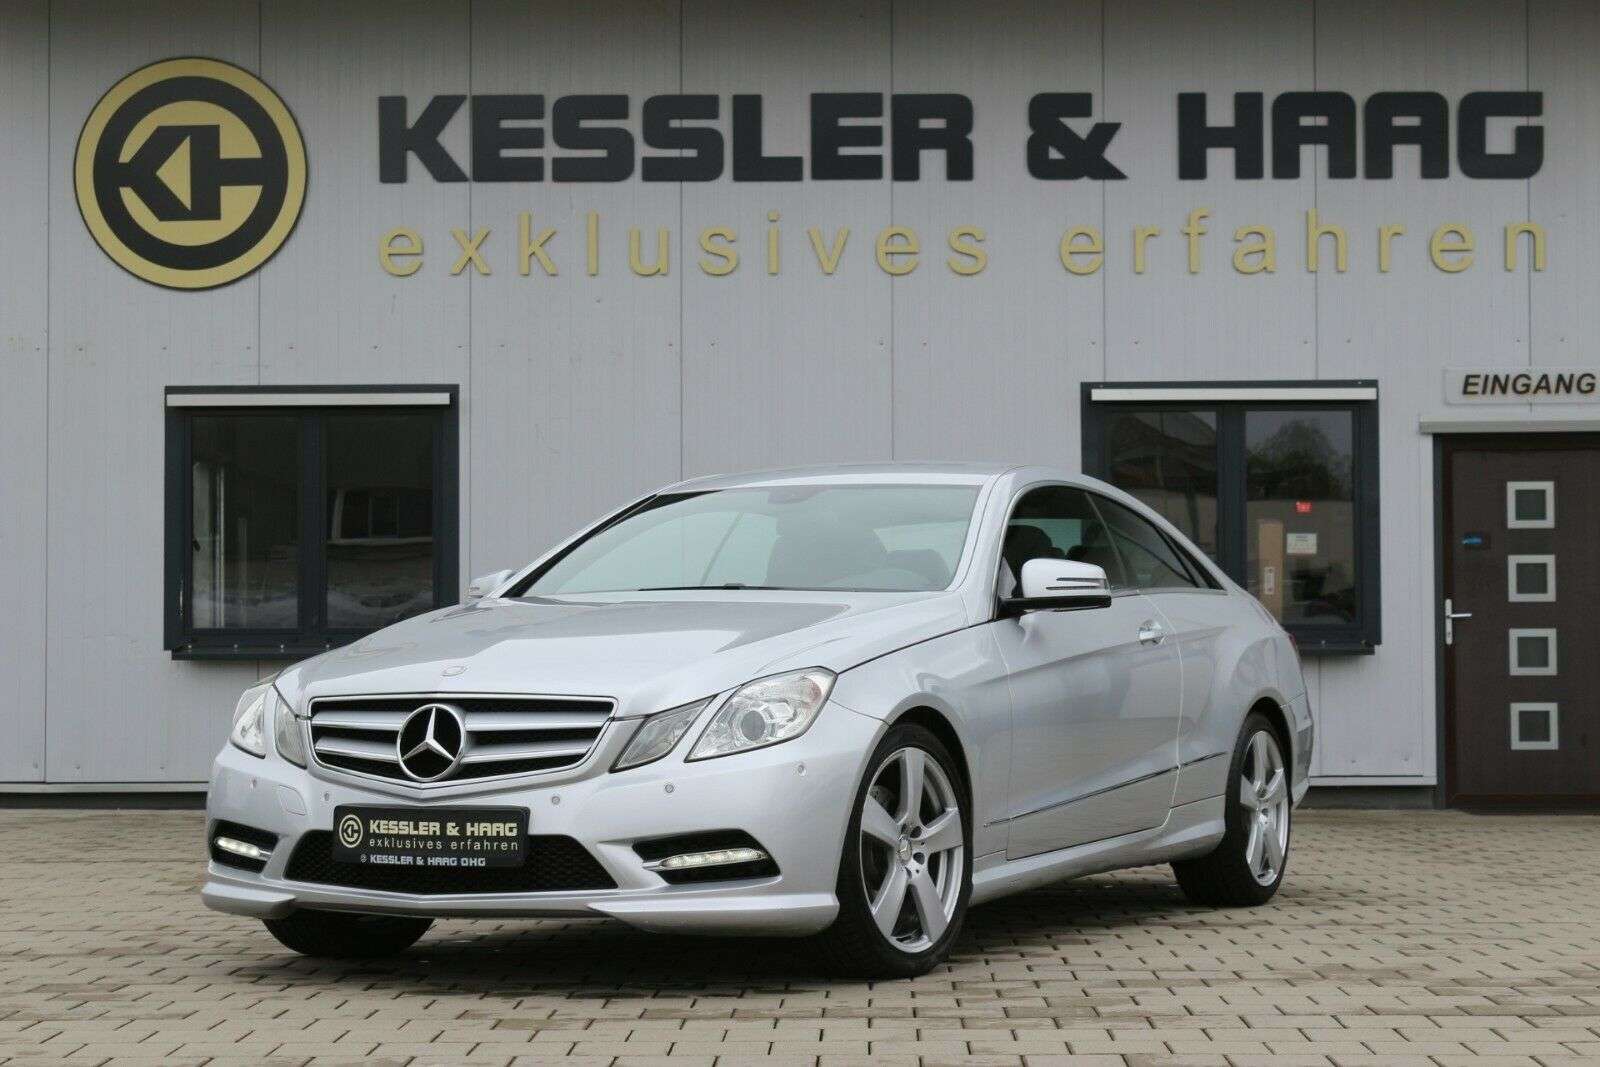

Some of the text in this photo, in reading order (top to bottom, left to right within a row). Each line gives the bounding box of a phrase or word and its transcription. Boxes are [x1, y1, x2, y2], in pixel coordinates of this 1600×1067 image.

[378, 91, 1545, 183] KESSLER & HAAG
[379, 207, 1549, 277] exklusives erfahren
[1462, 373, 1596, 395] EINGANG
[370, 820, 518, 837] KESSLER & HAAG
[369, 838, 519, 851] exklusives erfahren
[370, 855, 413, 865] KESSLER
[415, 856, 425, 866] &
[427, 857, 458, 866] HAAG
